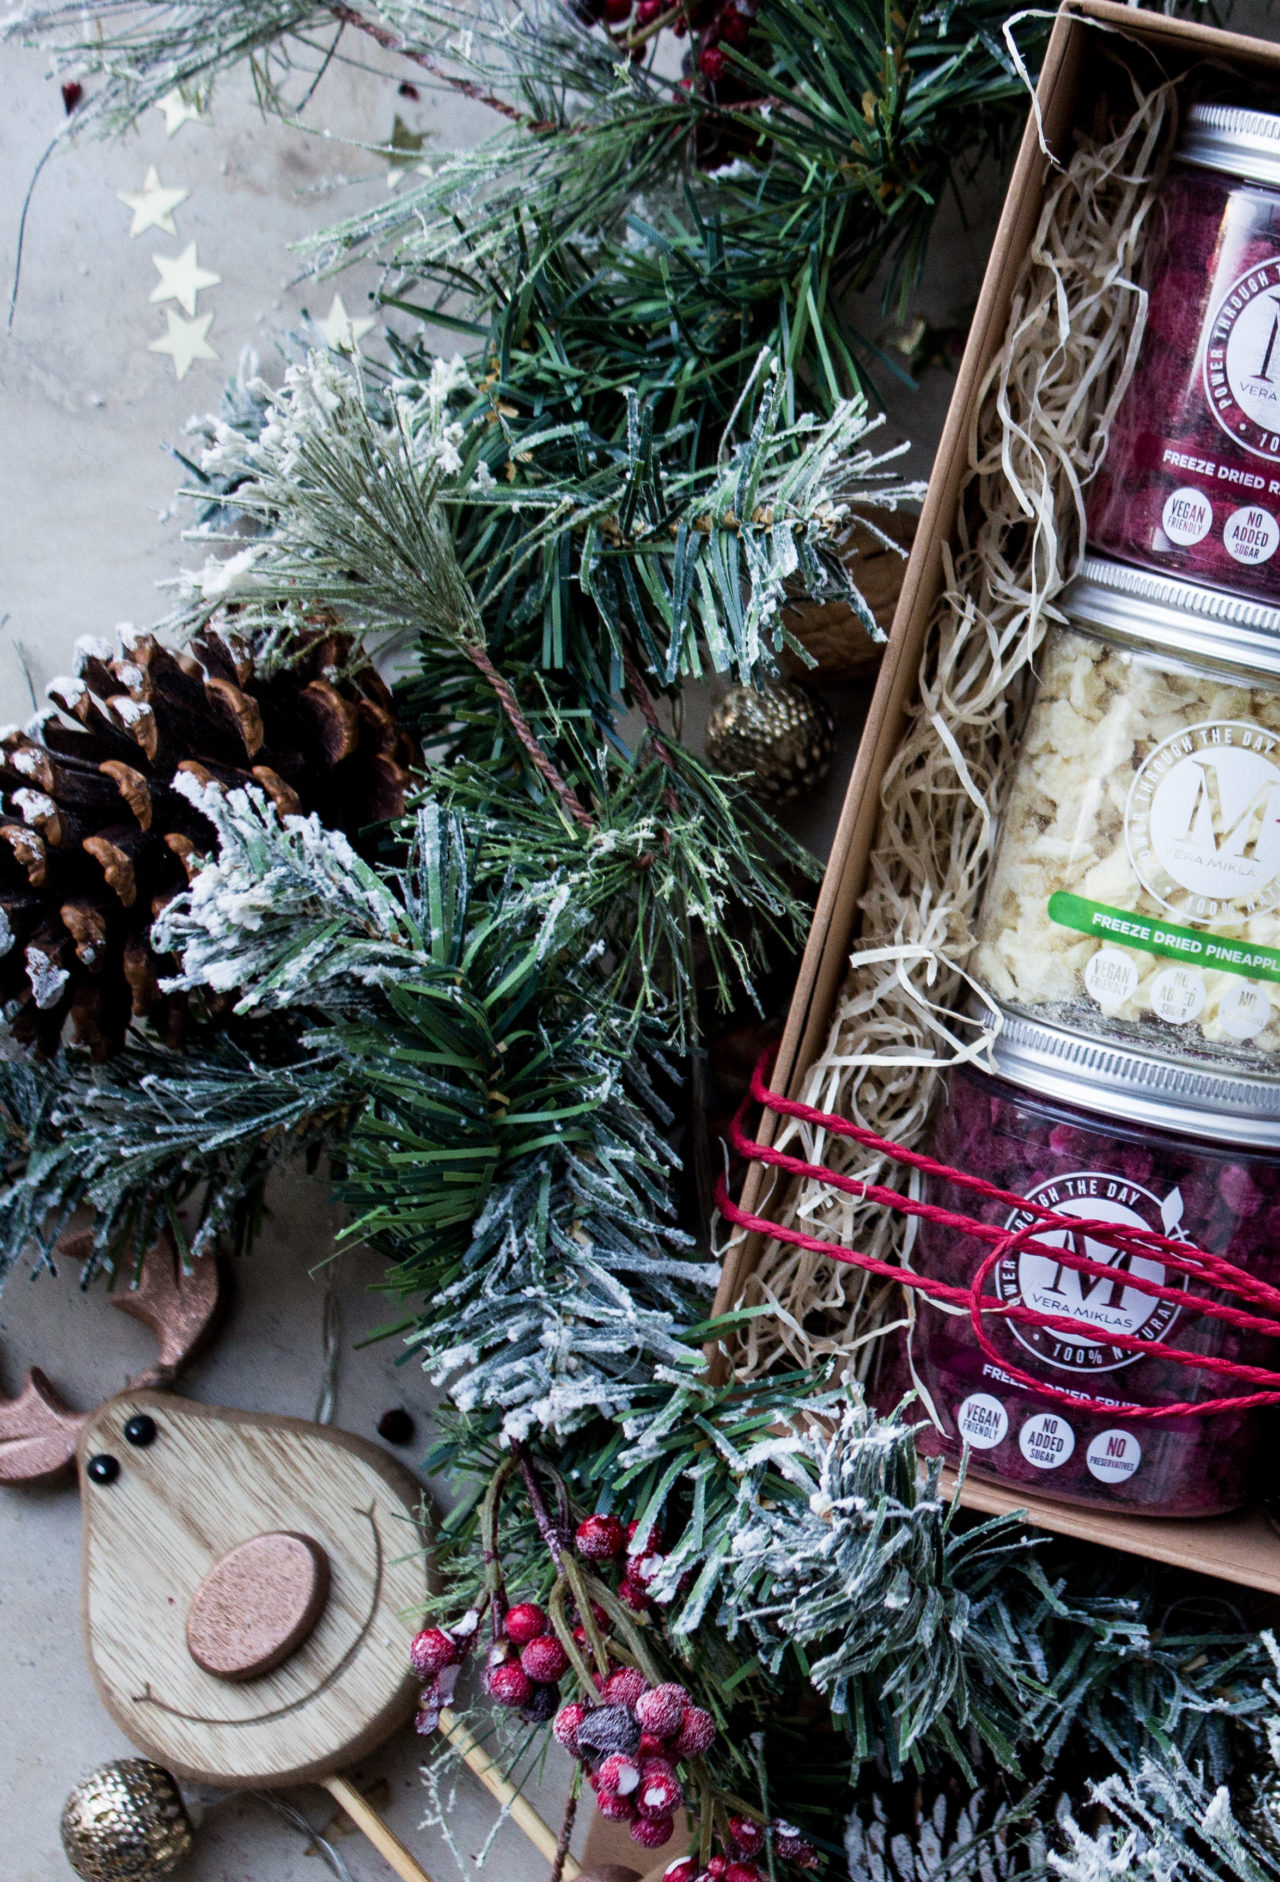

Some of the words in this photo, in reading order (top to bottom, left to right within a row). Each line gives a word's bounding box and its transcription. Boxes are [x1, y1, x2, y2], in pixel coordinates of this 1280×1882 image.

[1215, 271, 1269, 339] THROUGH
[1210, 348, 1233, 410] POWER
[1239, 382, 1278, 401] VERA
[1163, 449, 1216, 476] FREEZE
[1218, 466, 1265, 490] DRIED
[1171, 499, 1206, 524] VEGAN
[1247, 511, 1263, 528] NO
[1168, 516, 1203, 536] FRIENDLY
[1232, 526, 1269, 547] ADDED
[1234, 543, 1260, 559] SUGAR
[1135, 736, 1193, 802] THROUGH
[1200, 728, 1232, 746] THE
[1241, 731, 1276, 755] DAY
[1092, 912, 1151, 940] FREEZE
[1153, 930, 1203, 954] DRIED
[1065, 1180, 1098, 1197] THE
[1106, 1182, 1141, 1207] DAY
[1042, 1211, 1142, 1311] M
[1032, 1293, 1070, 1314] VERA
[1073, 1307, 1134, 1329] MIKLAS
[1053, 1343, 1102, 1365] 100%
[966, 1403, 1002, 1427] VEGAN
[962, 1419, 1000, 1440] FRIENDLY
[1042, 1418, 1057, 1435] NO
[1027, 1431, 1064, 1452] ADDED
[1106, 1437, 1127, 1458] NO
[1030, 1448, 1055, 1464] SUGAR
[1089, 1456, 1135, 1472] PRESERVATIVES
